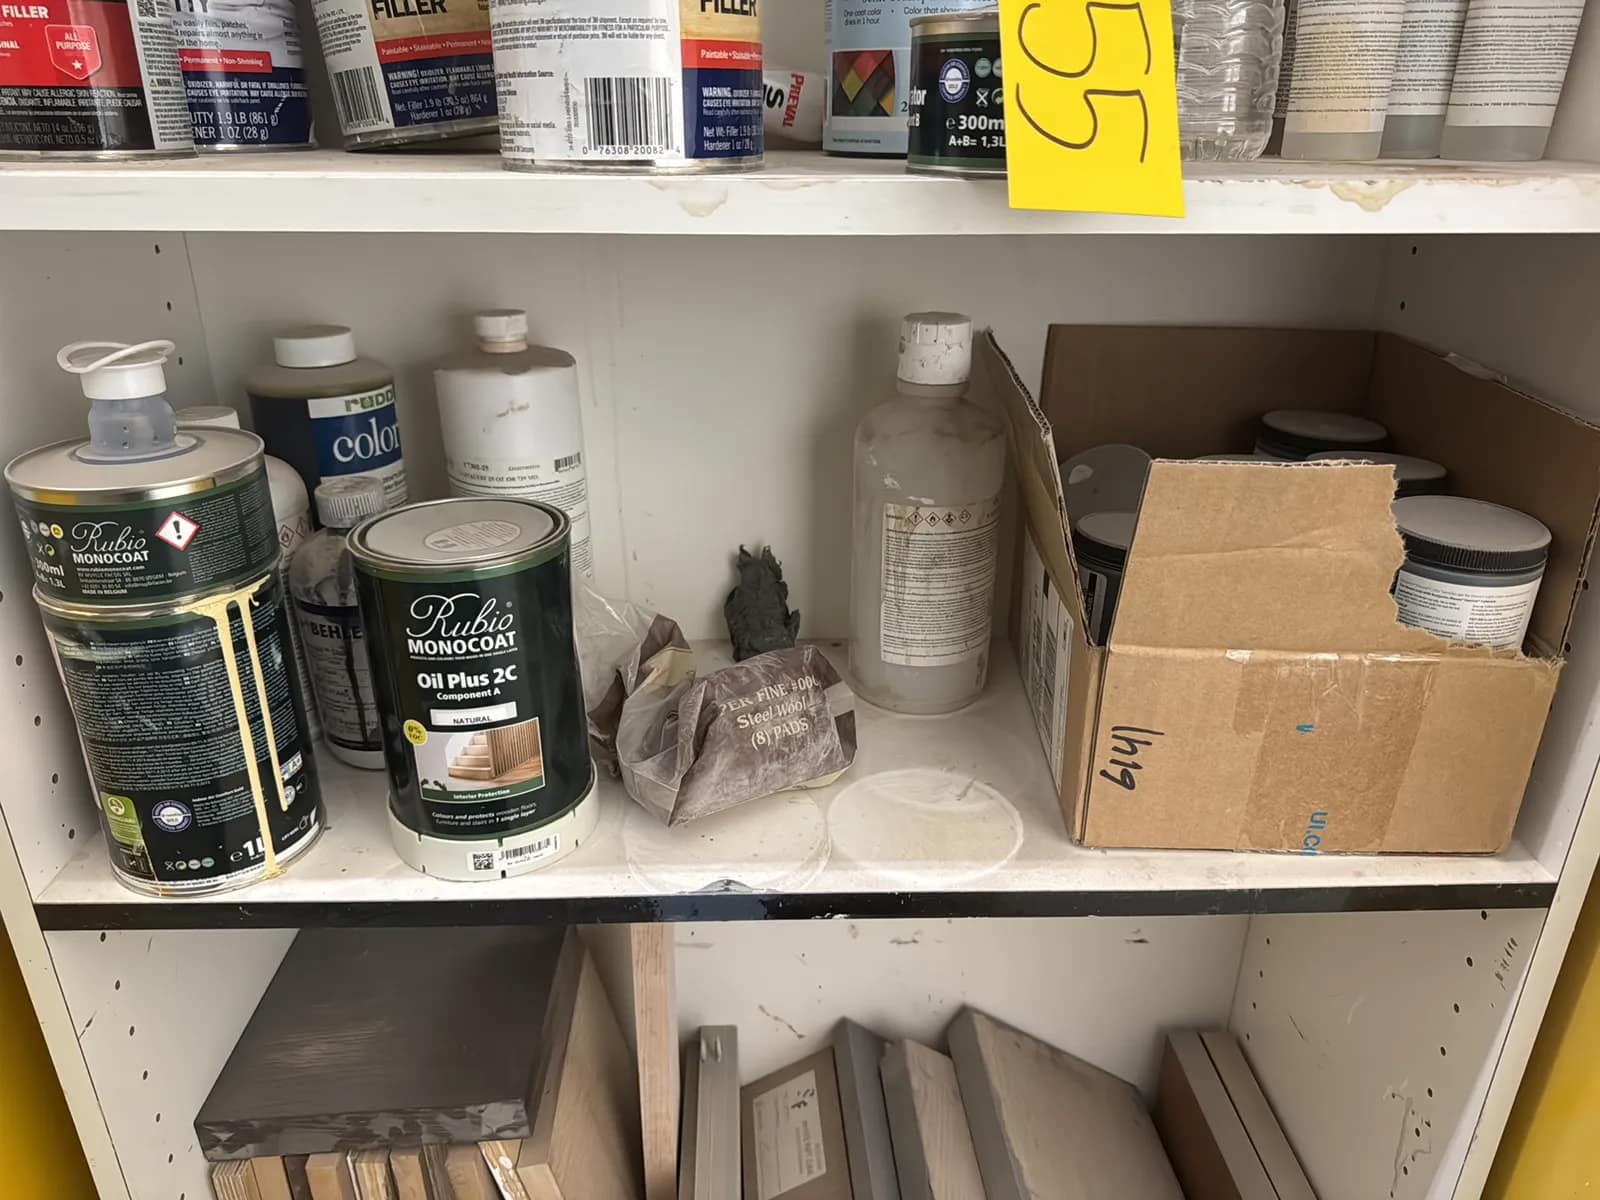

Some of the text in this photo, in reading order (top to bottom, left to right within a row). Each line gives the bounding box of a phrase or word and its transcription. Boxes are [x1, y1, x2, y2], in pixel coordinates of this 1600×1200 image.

[2, 5, 49, 18] FILLER
[903, 6, 922, 15] Color
[923, 6, 938, 14] that
[55, 41, 91, 51] PURPOSE
[218, 111, 232, 124] 1.9
[235, 112, 247, 124] LB
[249, 112, 268, 125] (861
[220, 127, 225, 139] 1
[227, 127, 241, 139] OZ
[243, 126, 258, 139] (28
[260, 126, 269, 141] g)
[70, 521, 146, 552] Rubio
[72, 550, 150, 565] MONOCOAT
[406, 592, 514, 638] Rubio
[407, 630, 517, 656] MONOCOAT
[417, 664, 518, 690] Oil Plus 2C
[436, 687, 502, 701] Component A
[756, 683, 788, 702] FINE
[453, 715, 492, 725] NATURAL
[736, 696, 808, 729] Steel Wool
[751, 717, 809, 751] (8) PADS
